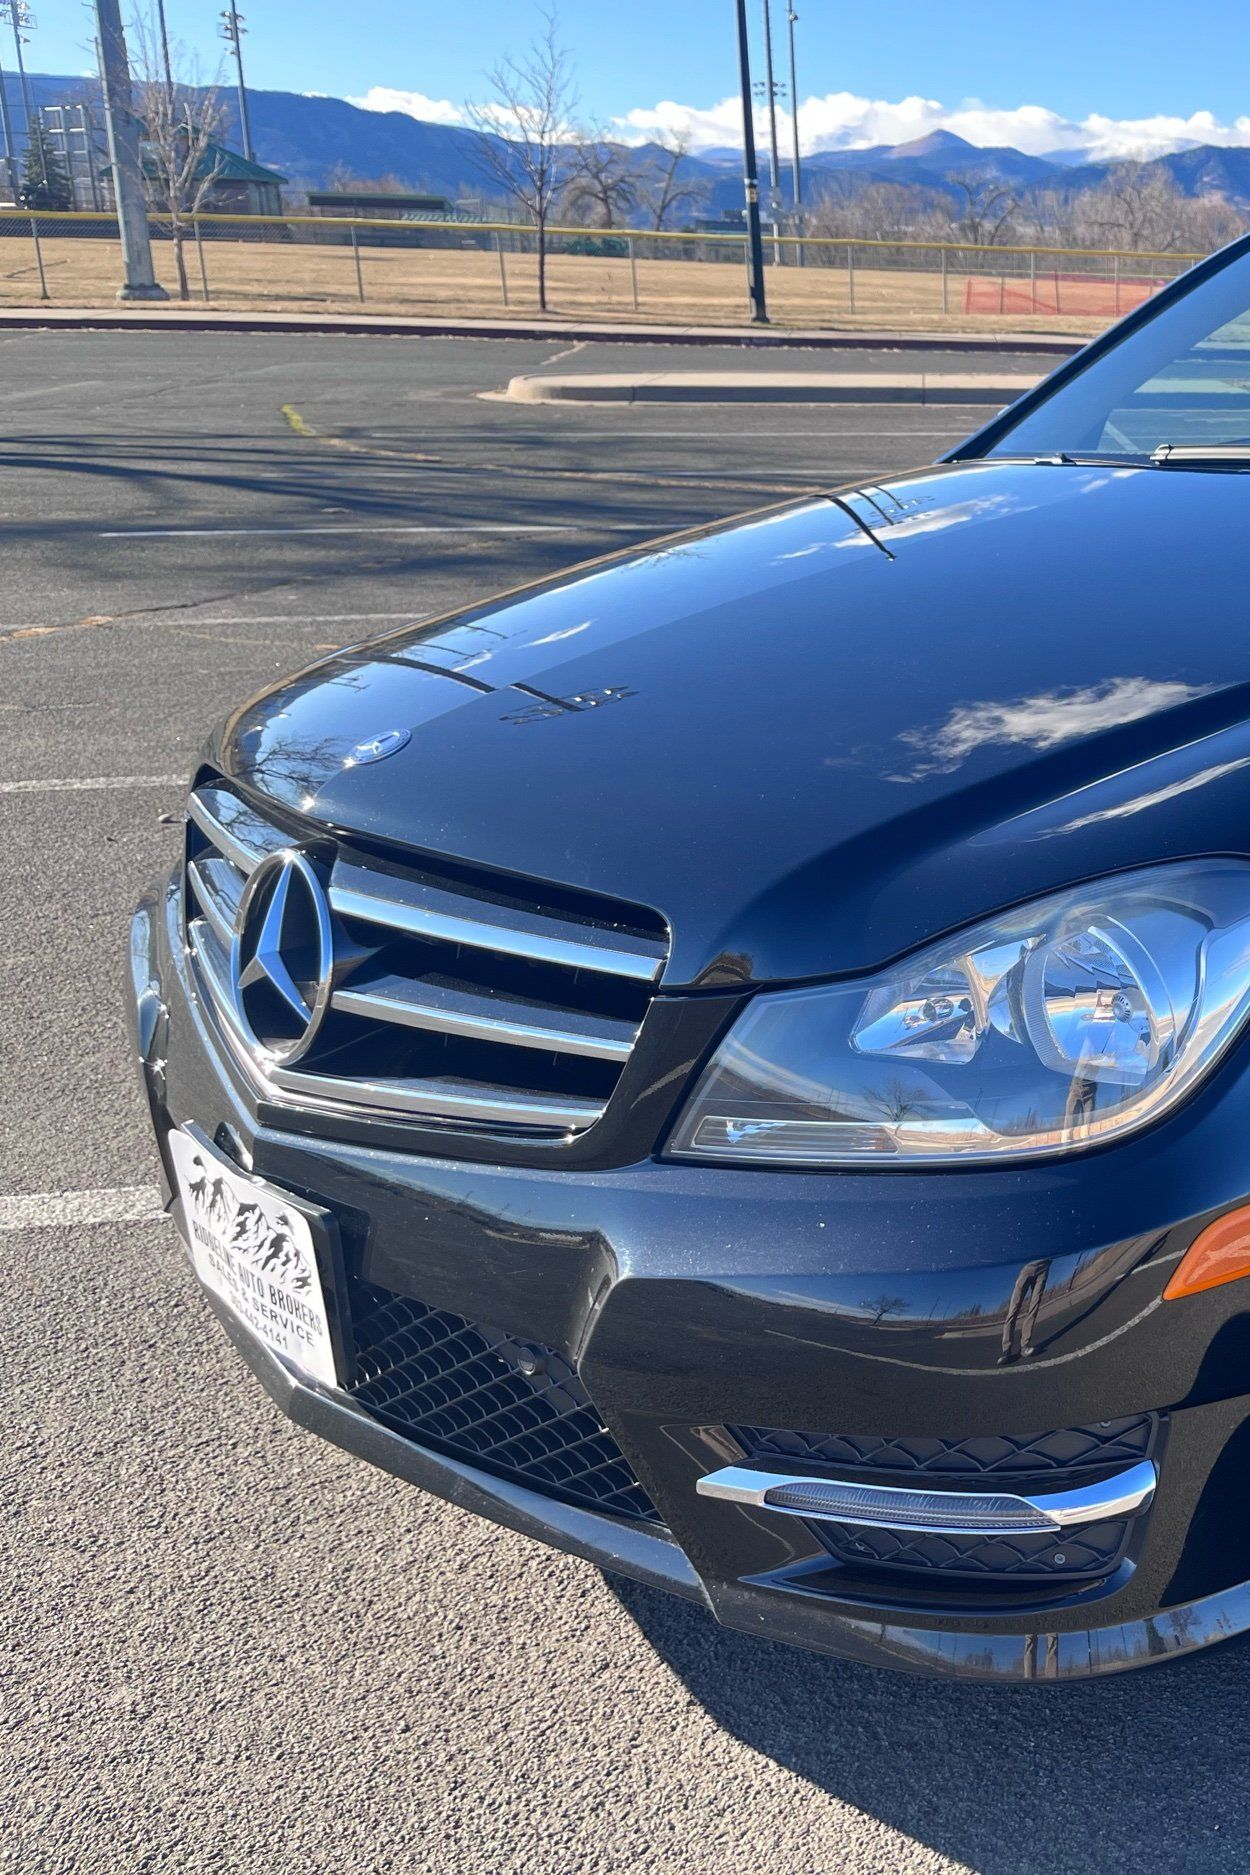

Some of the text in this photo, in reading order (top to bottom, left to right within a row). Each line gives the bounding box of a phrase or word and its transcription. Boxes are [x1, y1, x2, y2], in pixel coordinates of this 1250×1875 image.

[192, 1220, 323, 1337] RIDGELINE AUTO BROKERS
[208, 1253, 314, 1347] SALES & SERVICE
